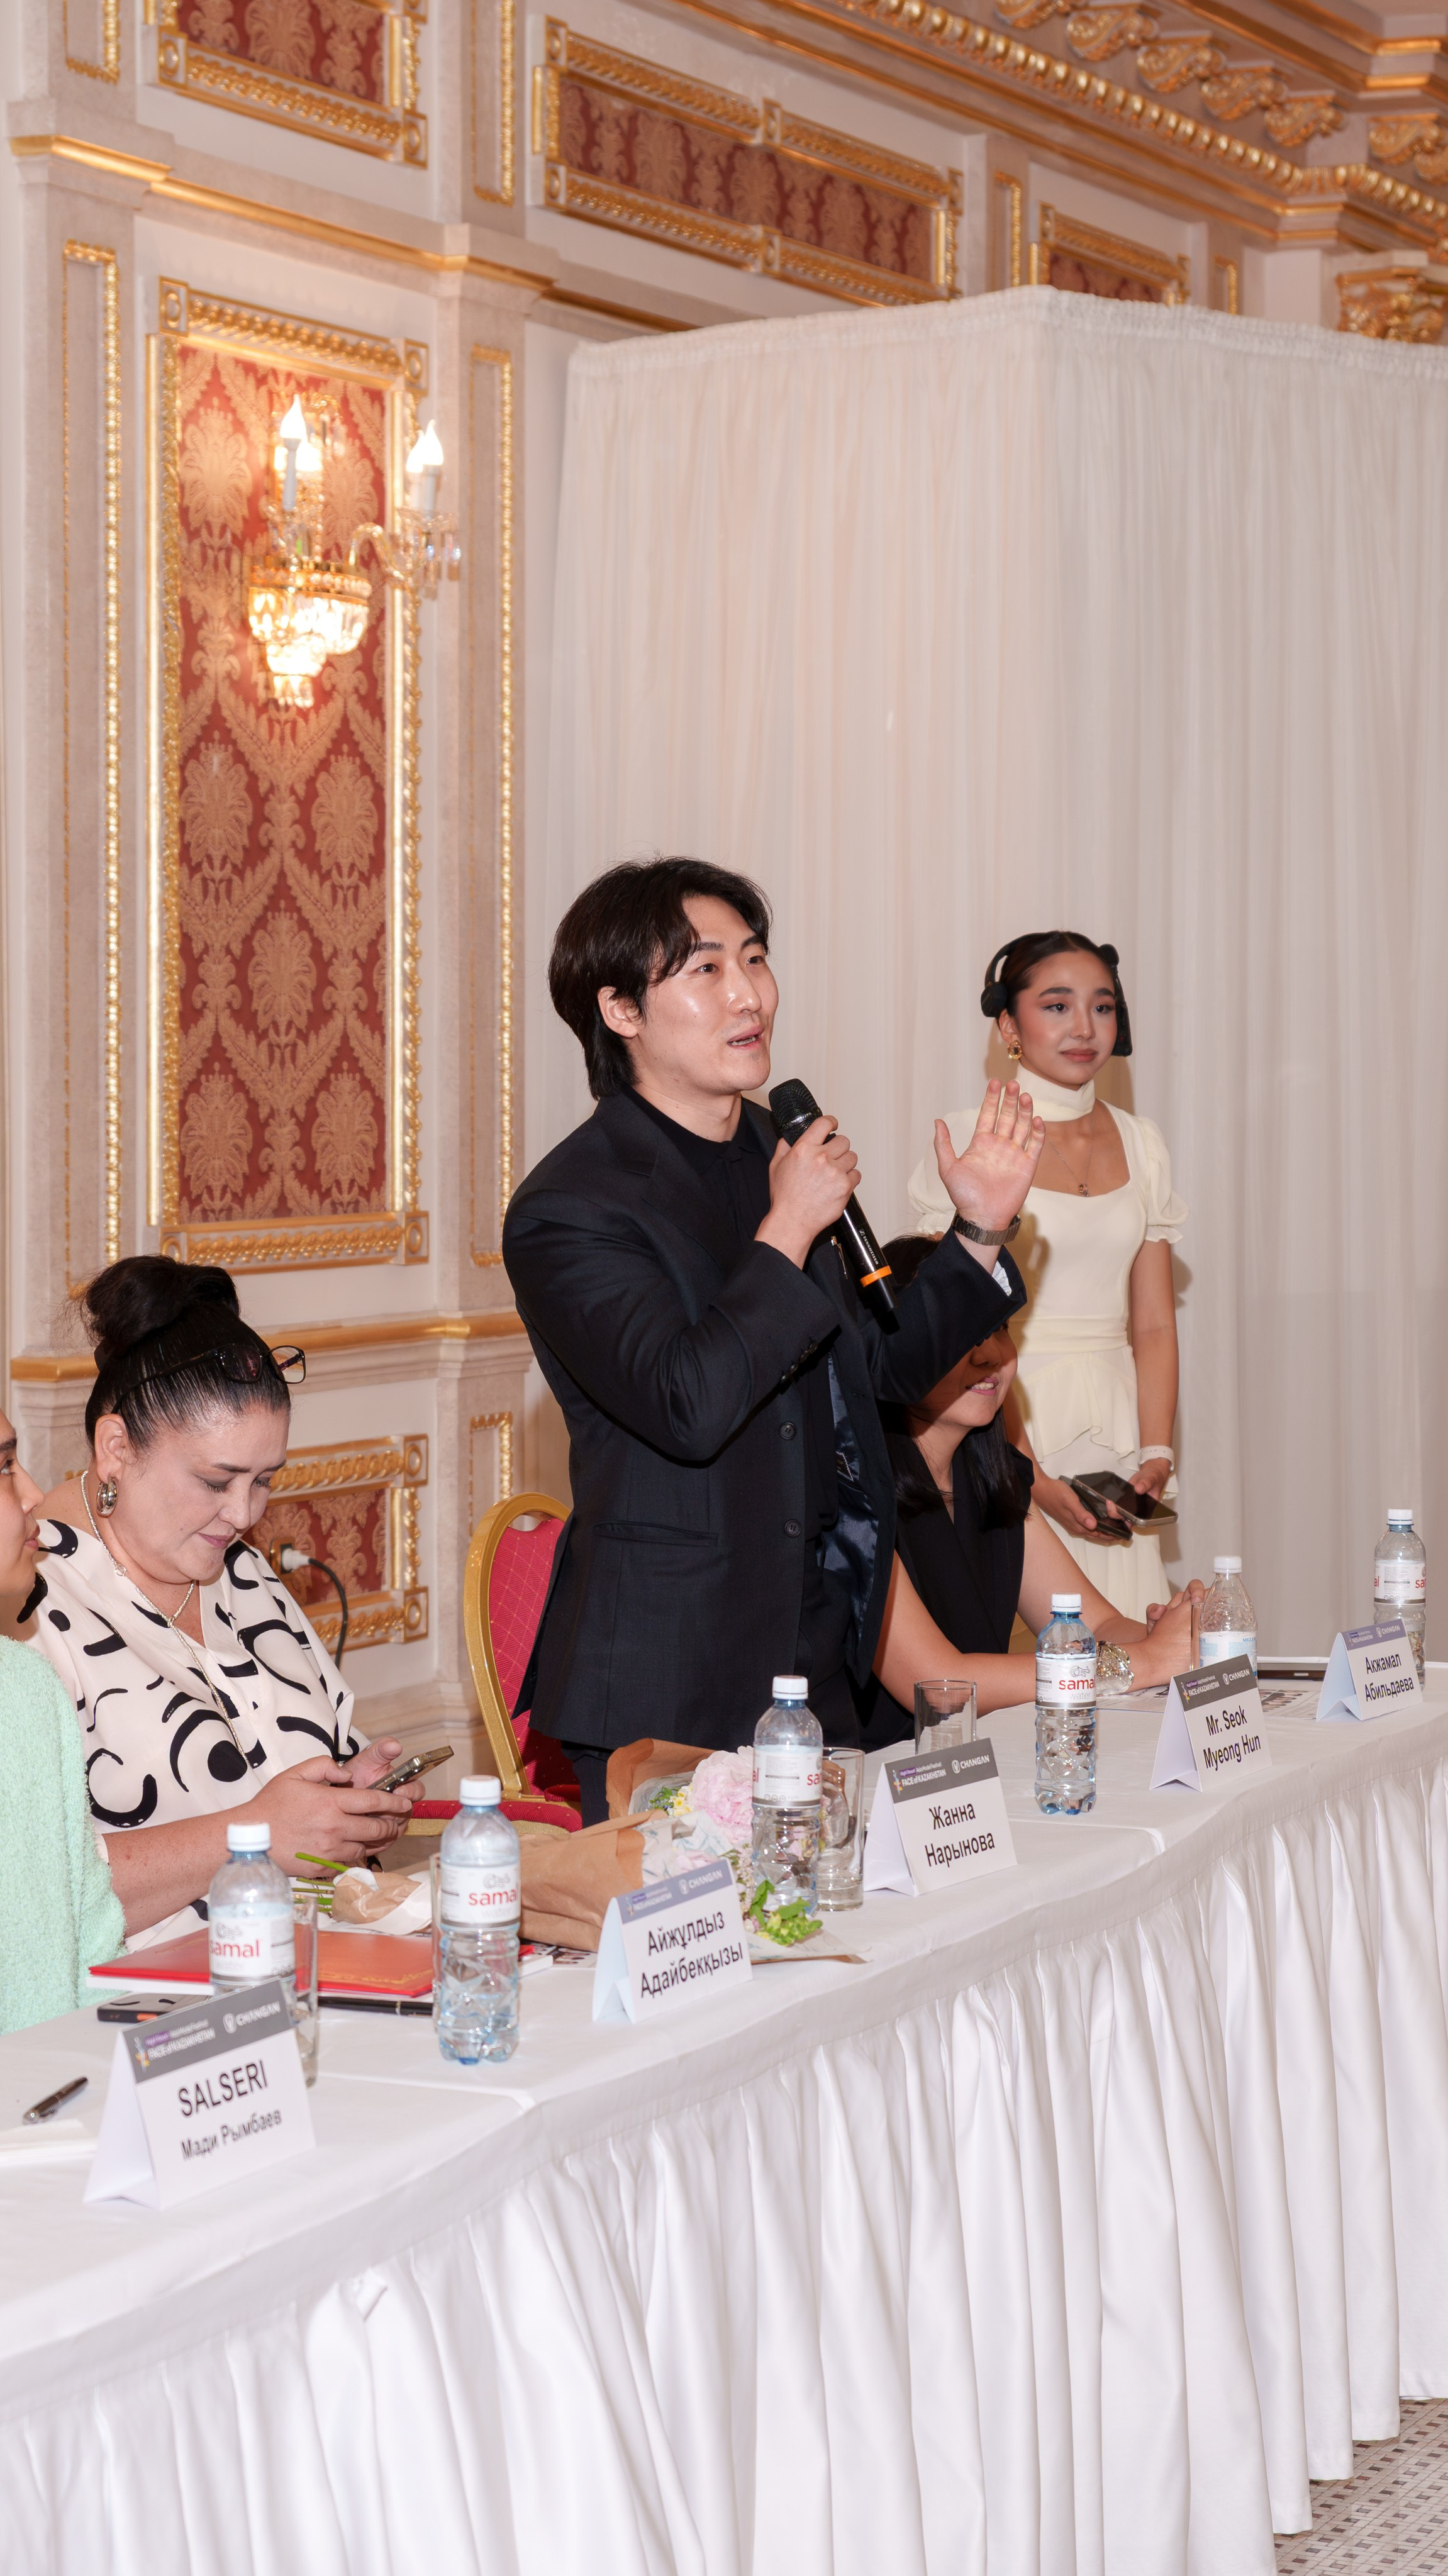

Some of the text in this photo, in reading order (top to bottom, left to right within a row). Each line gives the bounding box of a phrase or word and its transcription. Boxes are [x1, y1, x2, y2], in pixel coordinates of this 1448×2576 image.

[863, 1236, 879, 1265] SENNHEISER
[1382, 1625, 1401, 1635] CHANGAN
[1229, 1668, 1250, 1681] CHANGAN
[1366, 1654, 1401, 1674] Акжамал
[1059, 1675, 1095, 1690] samal
[1199, 1681, 1220, 1692] KAZAKHSTAN
[1365, 1677, 1414, 1702] Абильдаева
[1205, 1706, 1247, 1736] Mr. Seok
[961, 1755, 989, 1769] CHANGAN
[1203, 1735, 1261, 1771] Myeong Hun
[901, 1777, 914, 1785] FACE
[918, 1768, 946, 1782] KAZAKHSTAN
[929, 1803, 976, 1829] Жанна
[925, 1833, 994, 1867] Нарынова
[689, 1869, 723, 1889] CHANGAN
[468, 1882, 518, 1905] samal
[649, 1911, 725, 1956] Айжұлдыз
[209, 1940, 259, 1958] samal
[641, 1943, 743, 1998] Адайбекқызы
[236, 2001, 281, 2026] CHANGAN
[178, 2059, 268, 2117] SALSERI
[181, 2109, 282, 2162] Мади Рымбаев
